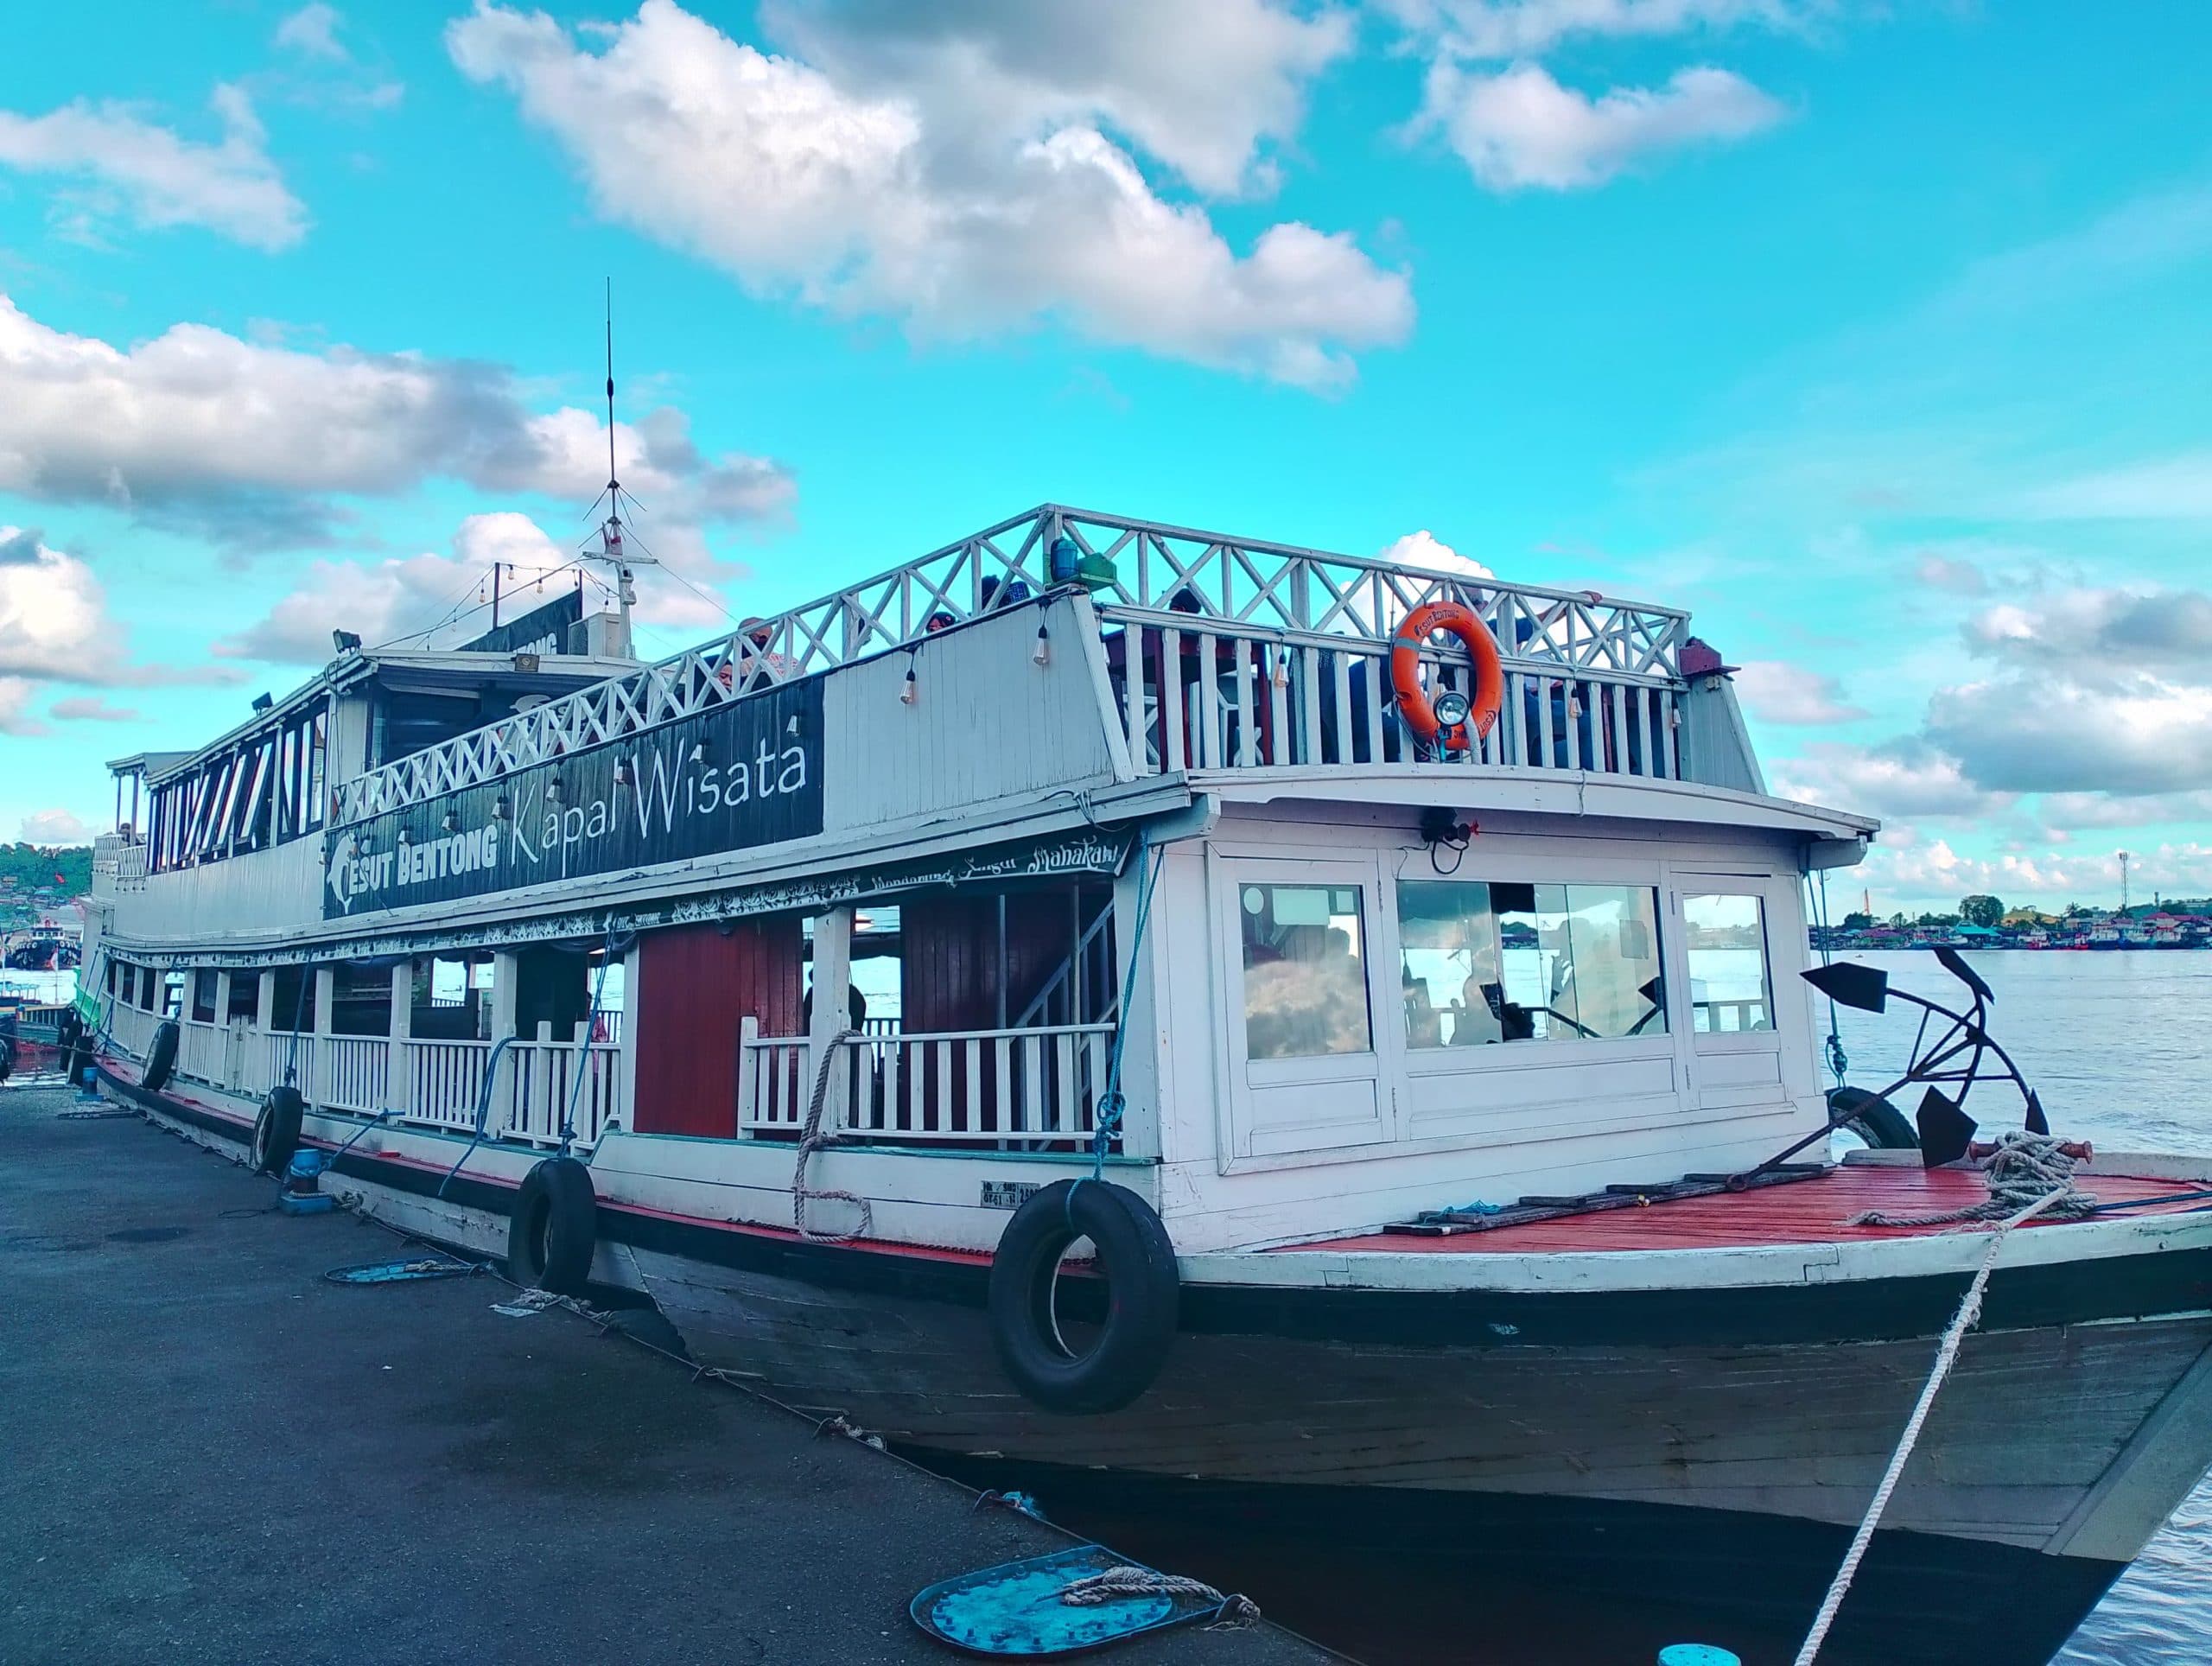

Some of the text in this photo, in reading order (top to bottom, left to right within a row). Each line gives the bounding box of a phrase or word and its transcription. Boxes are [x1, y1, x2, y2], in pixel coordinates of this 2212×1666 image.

[397, 824, 498, 886] BENTONG
[511, 755, 619, 878] Kapal
[632, 737, 807, 840] Wisata
